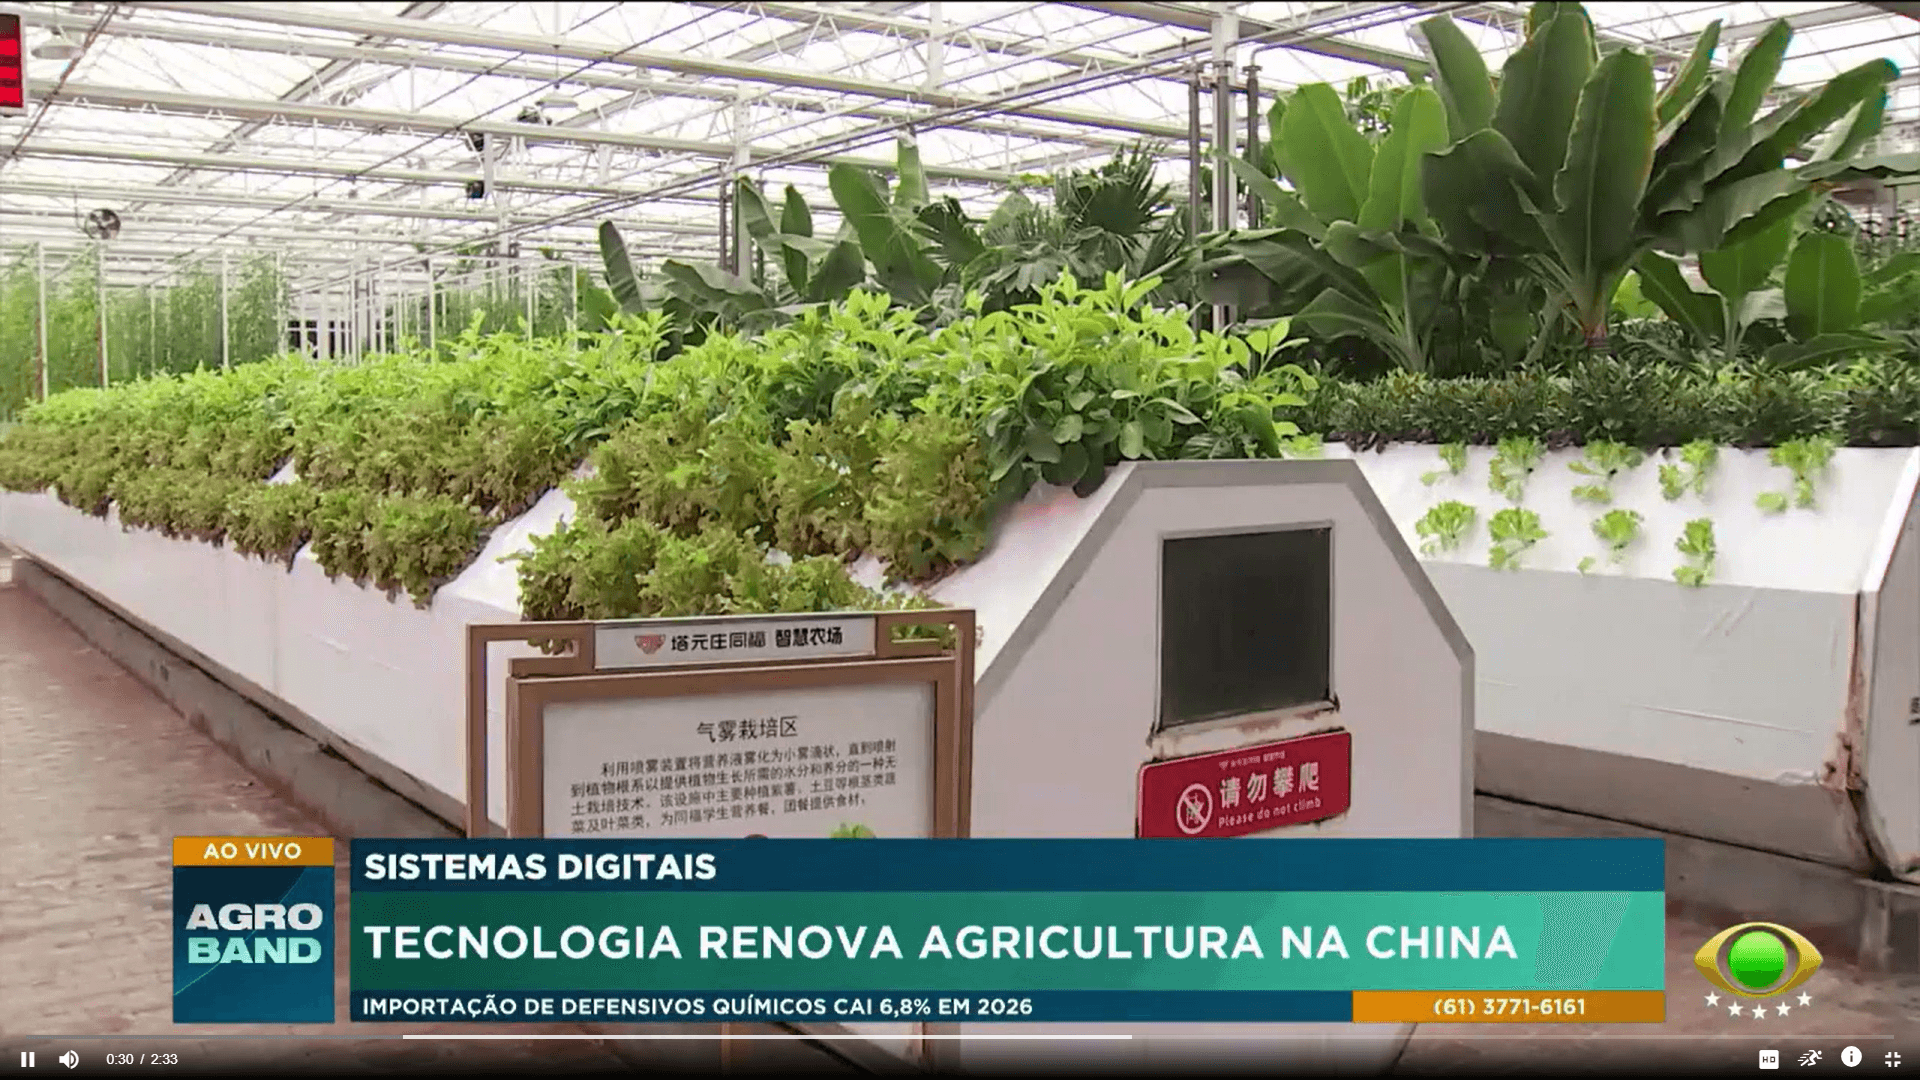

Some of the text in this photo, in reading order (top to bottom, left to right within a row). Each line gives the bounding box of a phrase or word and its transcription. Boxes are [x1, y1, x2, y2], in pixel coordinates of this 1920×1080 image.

[671, 626, 843, 651] 塔元庄同福 智慧农场
[697, 715, 798, 743] 气雾栽培区
[1219, 762, 1320, 809] 请勿攀爬
[1218, 797, 1322, 829] Please do not climb
